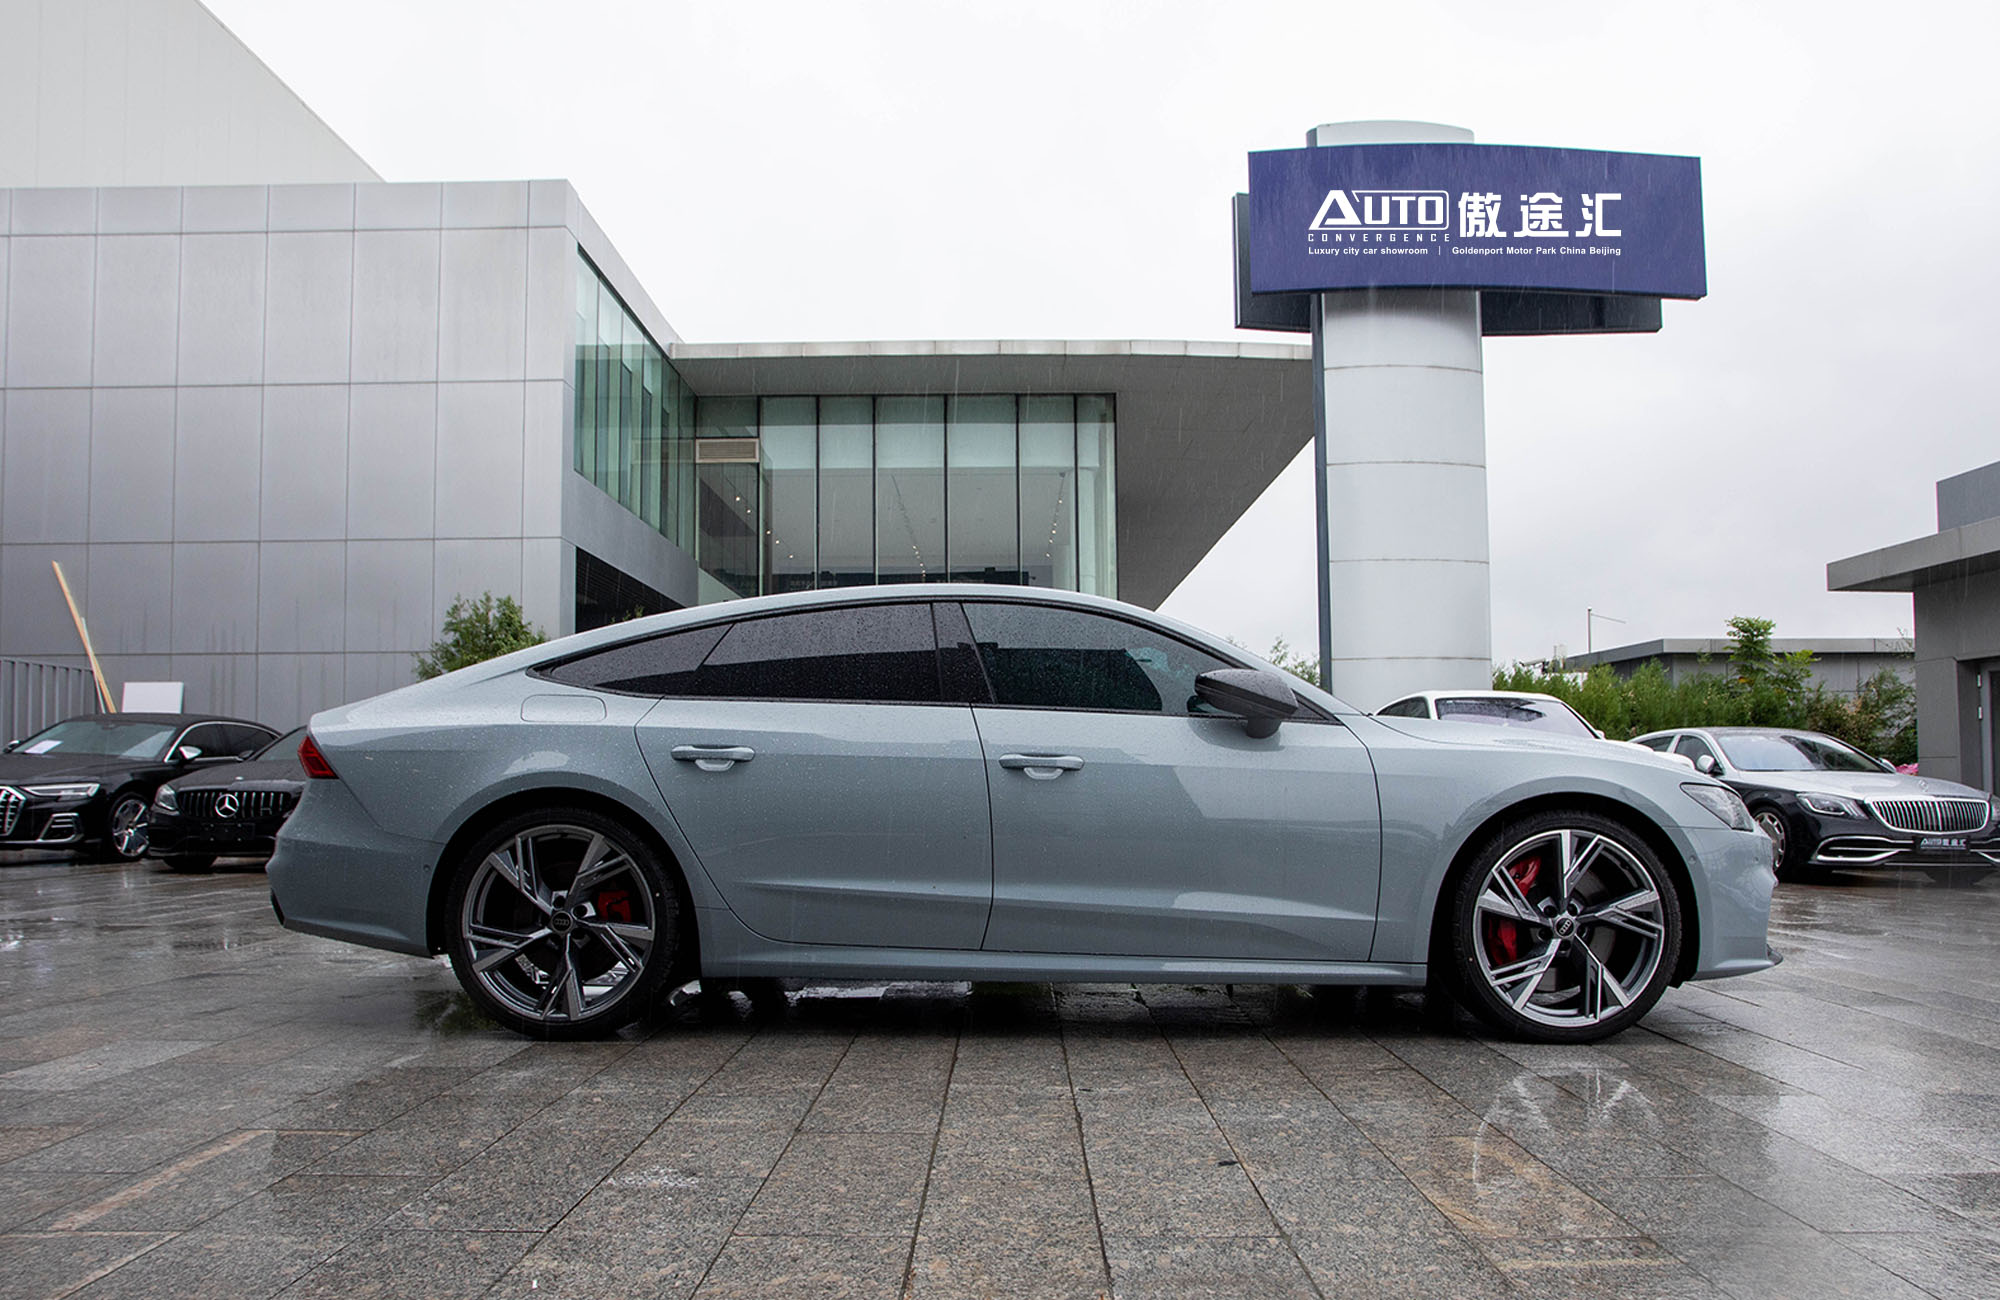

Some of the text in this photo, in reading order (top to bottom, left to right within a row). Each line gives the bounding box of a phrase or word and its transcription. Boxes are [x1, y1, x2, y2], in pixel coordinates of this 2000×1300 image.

[1308, 189, 1447, 230] AUTO
[1457, 191, 1622, 238] 傲途汇
[1307, 233, 1450, 242] CONVERGENCE
[1308, 246, 1340, 256] Luxury
[1343, 246, 1360, 256] city
[1380, 246, 1428, 255] showroom
[1451, 246, 1622, 256] Goldenport Motor Park China Beijing
